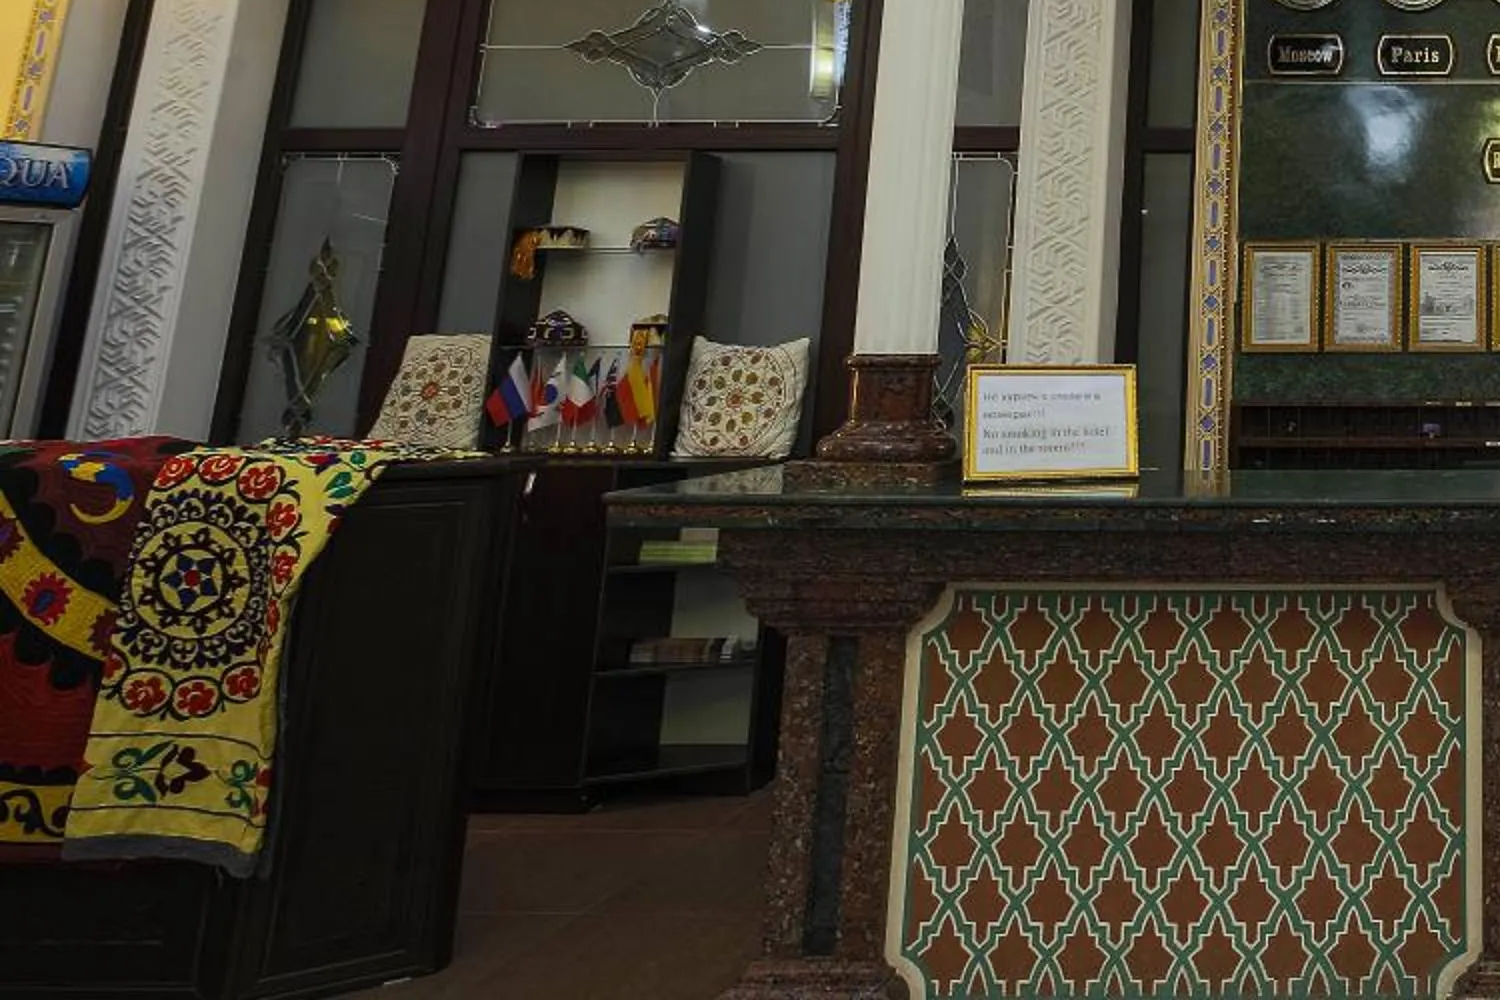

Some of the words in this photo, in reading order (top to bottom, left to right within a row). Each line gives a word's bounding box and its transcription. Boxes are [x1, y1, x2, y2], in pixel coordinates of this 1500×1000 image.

[1278, 45, 1333, 63] Moscow
[1391, 46, 1440, 63] Paris
[983, 428, 999, 439] No
[1001, 426, 1047, 440] smoking
[1063, 426, 1081, 438] the
[1083, 425, 1109, 437] hotel
